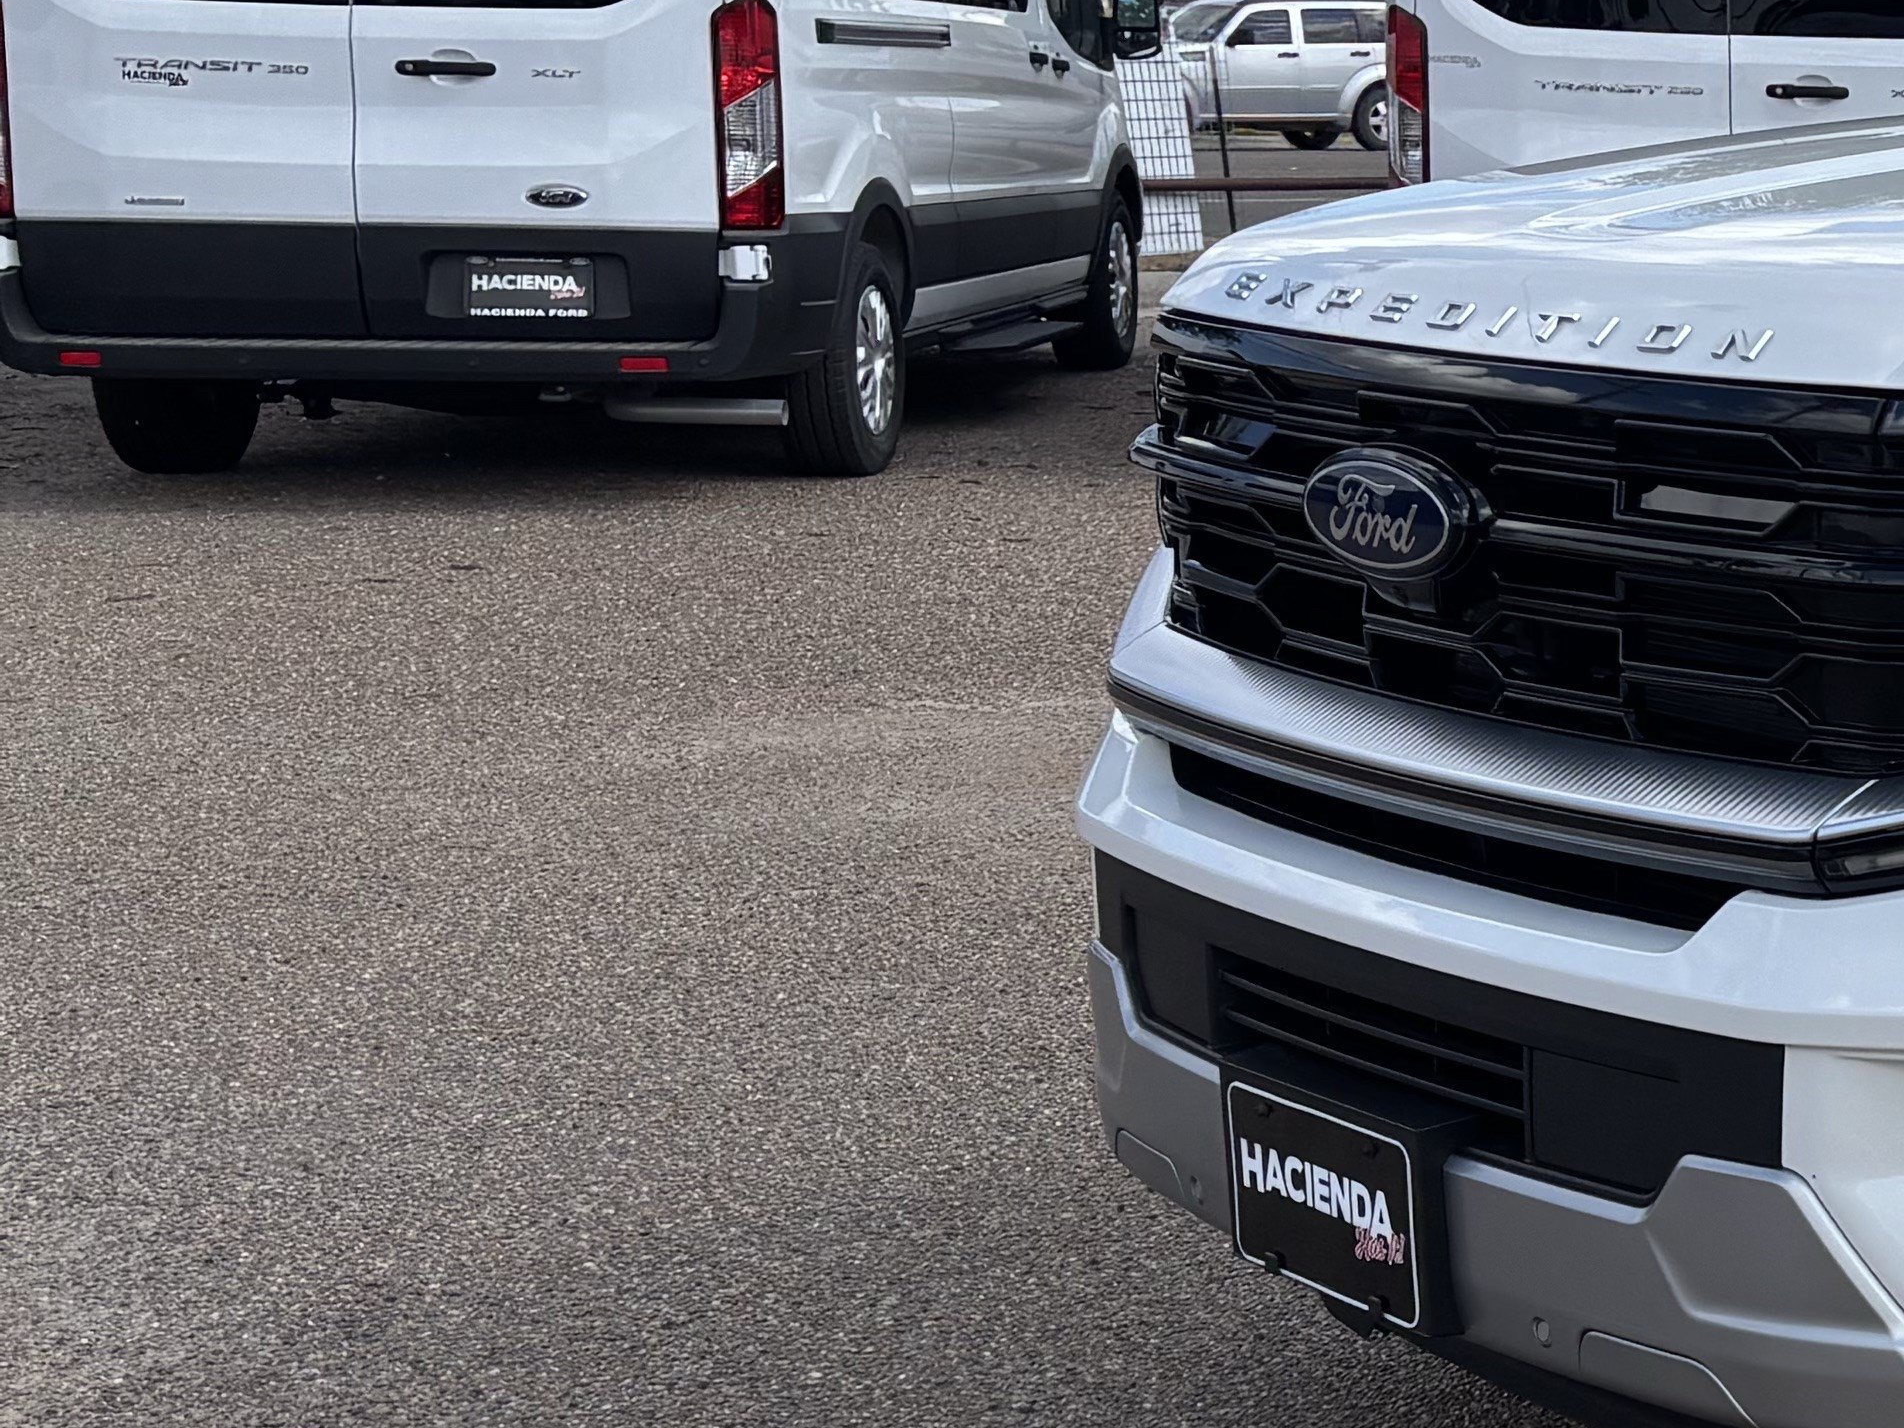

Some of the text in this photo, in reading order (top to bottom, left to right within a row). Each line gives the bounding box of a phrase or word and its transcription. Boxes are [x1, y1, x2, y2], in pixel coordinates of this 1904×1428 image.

[114, 57, 262, 73] TRANSIT
[531, 68, 582, 79] XLT
[122, 69, 184, 83] HACIENDA
[471, 274, 578, 292] HACIENDA
[470, 308, 589, 318] HACIENDA FORD
[1224, 271, 1776, 362] EXPEDITION
[1329, 473, 1419, 554] Ford
[1240, 1137, 1395, 1242] HACIENDA
